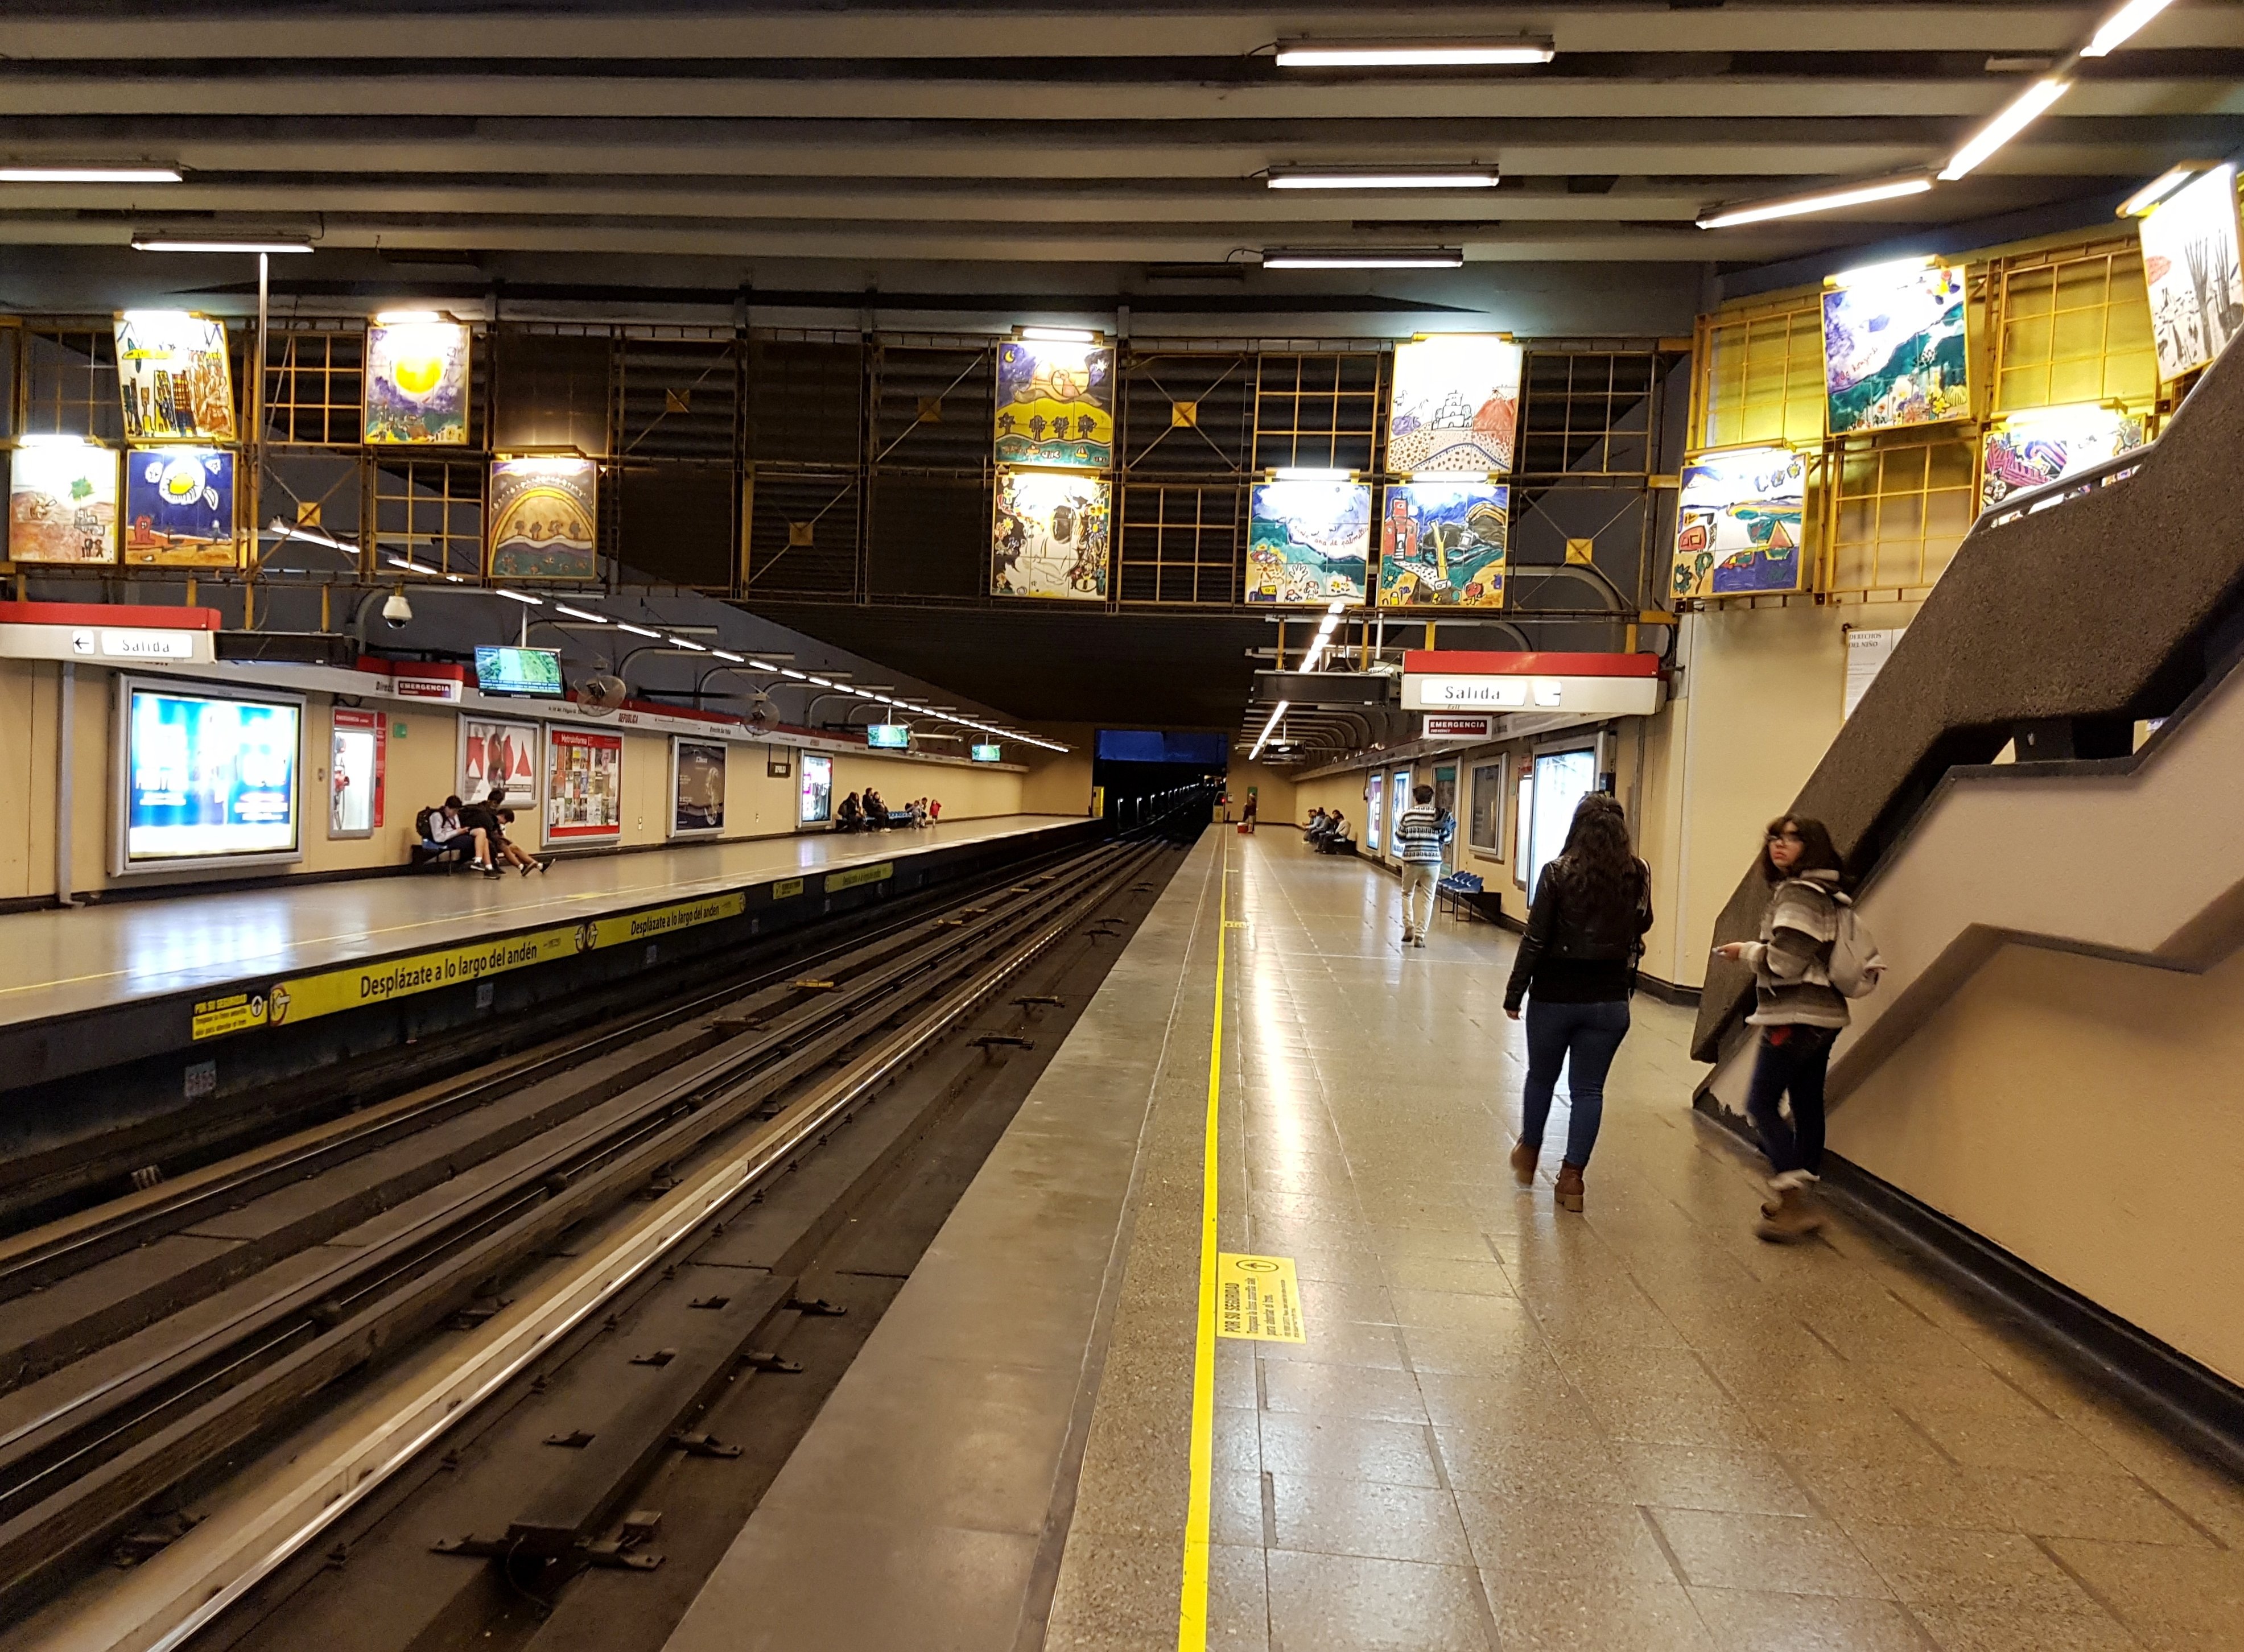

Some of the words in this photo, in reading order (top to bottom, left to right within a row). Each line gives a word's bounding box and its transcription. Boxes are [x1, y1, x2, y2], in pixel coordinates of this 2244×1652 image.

[122, 639, 170, 653] Salida
[399, 682, 449, 692] EMERGENCIA
[1445, 686, 1500, 700] Salida
[631, 916, 666, 936] Desplázate
[671, 911, 677, 926] lo
[678, 910, 693, 926] largo
[694, 906, 702, 920] del
[703, 903, 719, 918] andén
[361, 968, 432, 998] Desplázate
[435, 967, 442, 980] a
[445, 958, 456, 979] lo
[459, 955, 487, 977] largo
[489, 948, 506, 969] del
[508, 943, 537, 964] andén
[1224, 1321, 1241, 1333] POR
